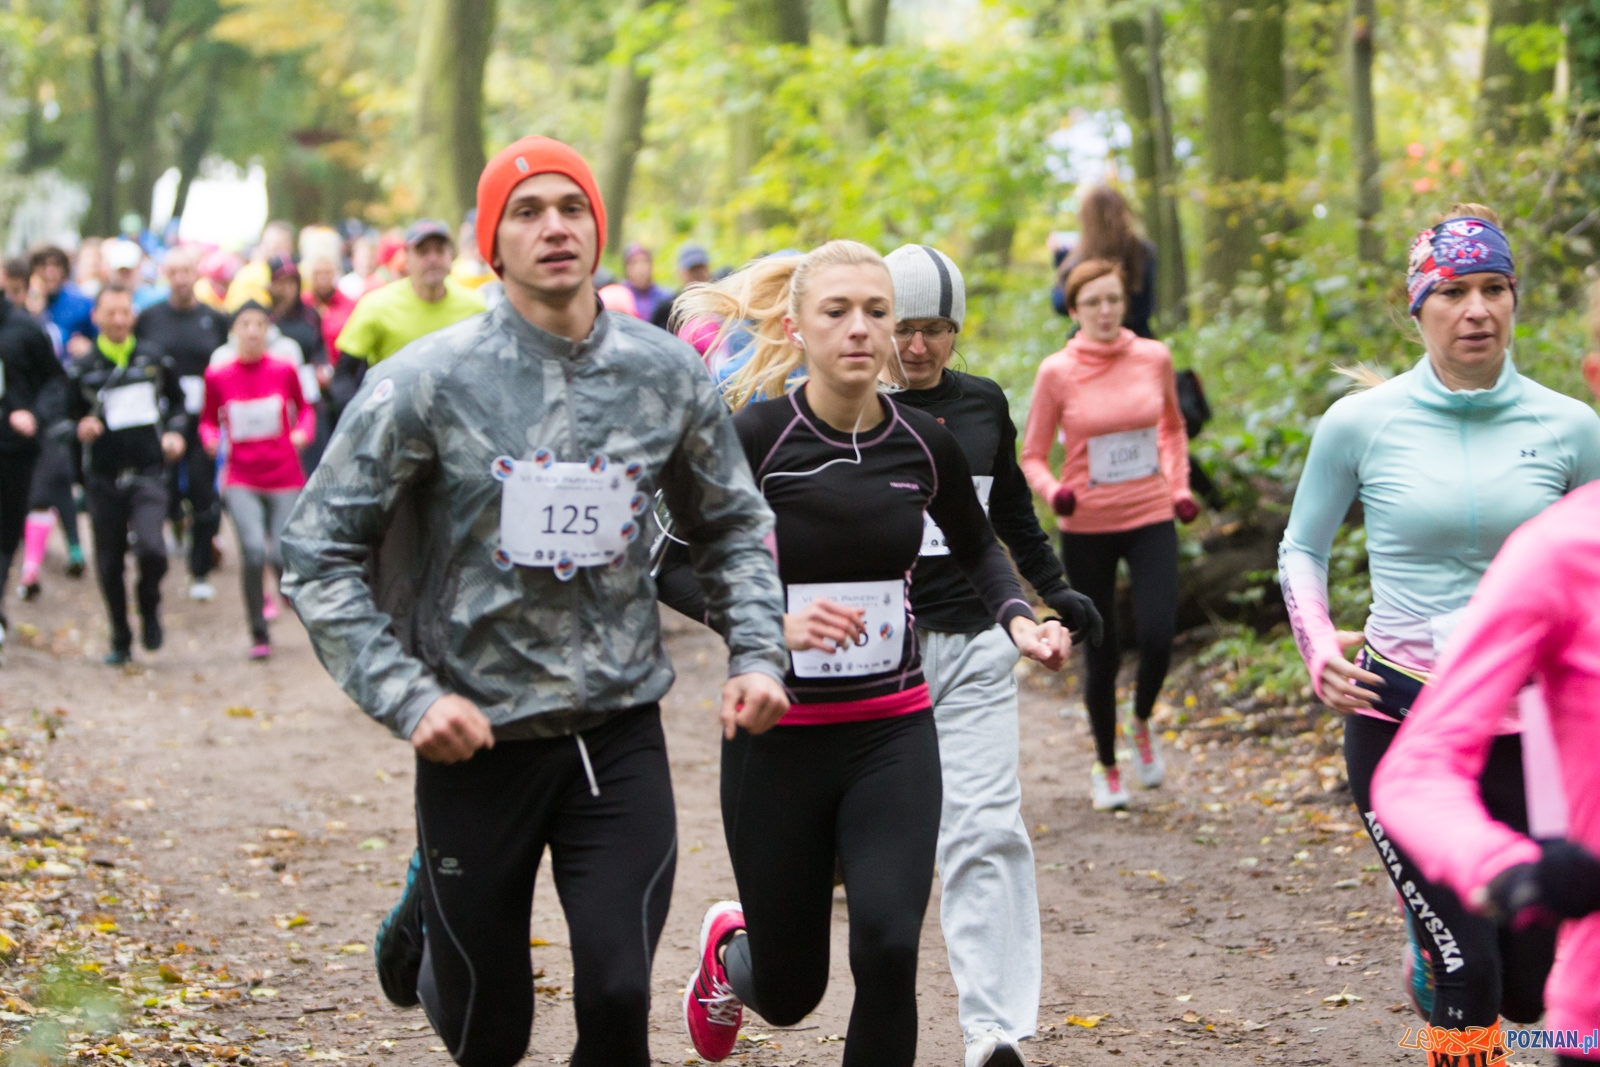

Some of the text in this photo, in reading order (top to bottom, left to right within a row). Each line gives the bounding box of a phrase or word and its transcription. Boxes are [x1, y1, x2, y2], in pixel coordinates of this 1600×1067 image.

[541, 504, 600, 535] 125
[1364, 810, 1465, 974] AGATA SZYSZKA
